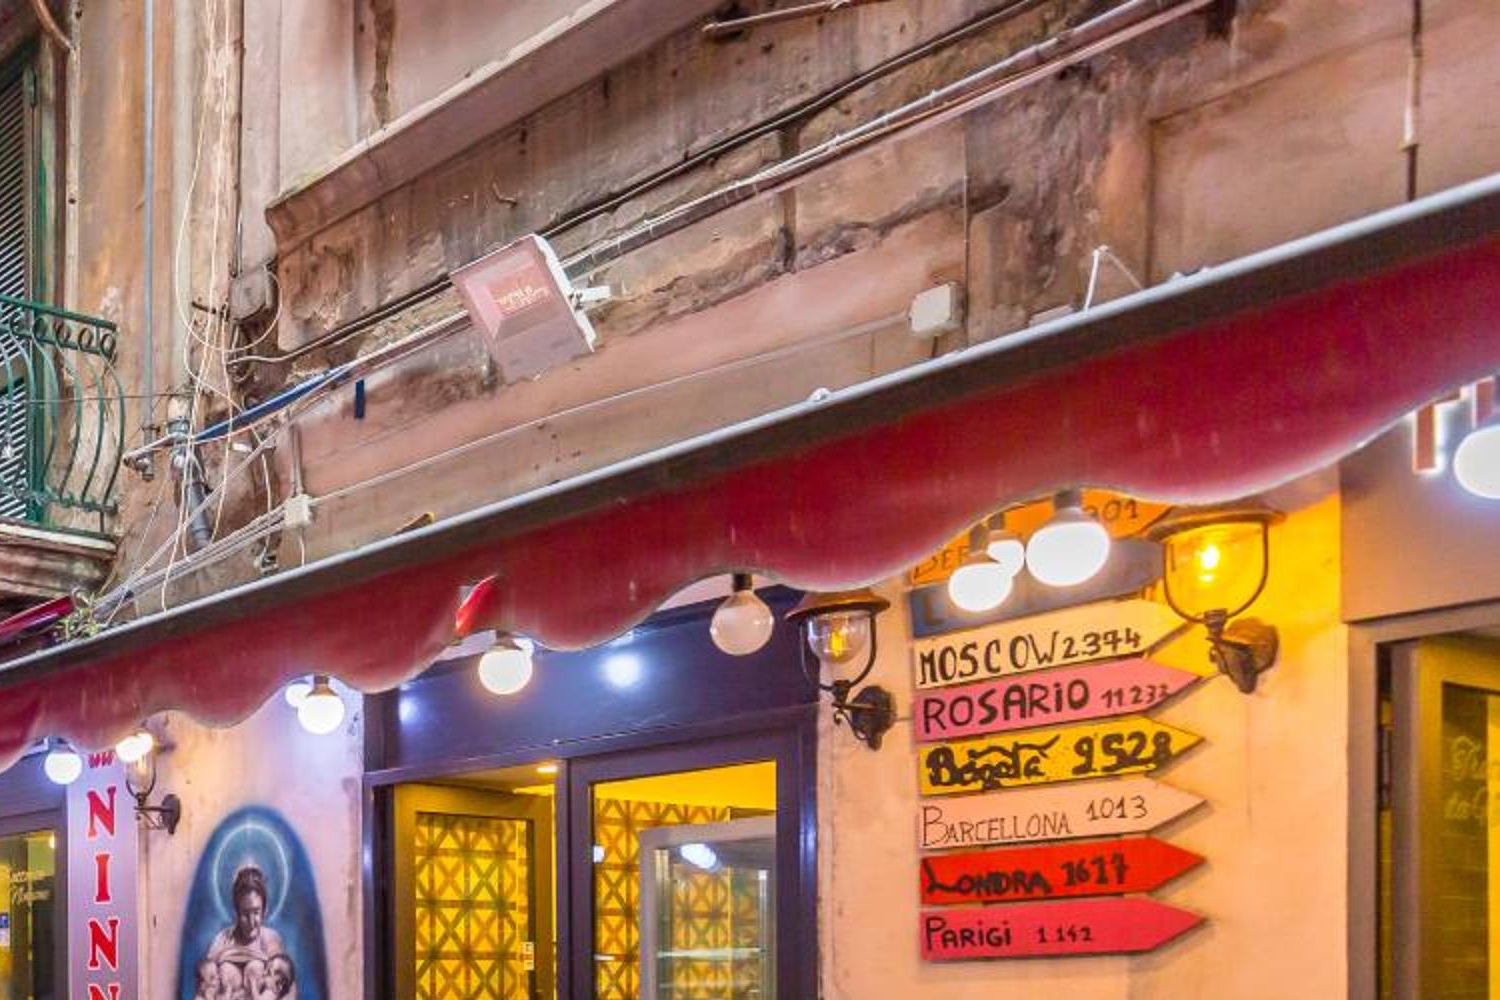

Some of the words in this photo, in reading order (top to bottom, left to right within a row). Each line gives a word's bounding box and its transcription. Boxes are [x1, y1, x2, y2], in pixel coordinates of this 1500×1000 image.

[919, 631, 1060, 684] MOSCOW
[921, 805, 1073, 846] BARCELLONA
[1085, 795, 1148, 820] 1013
